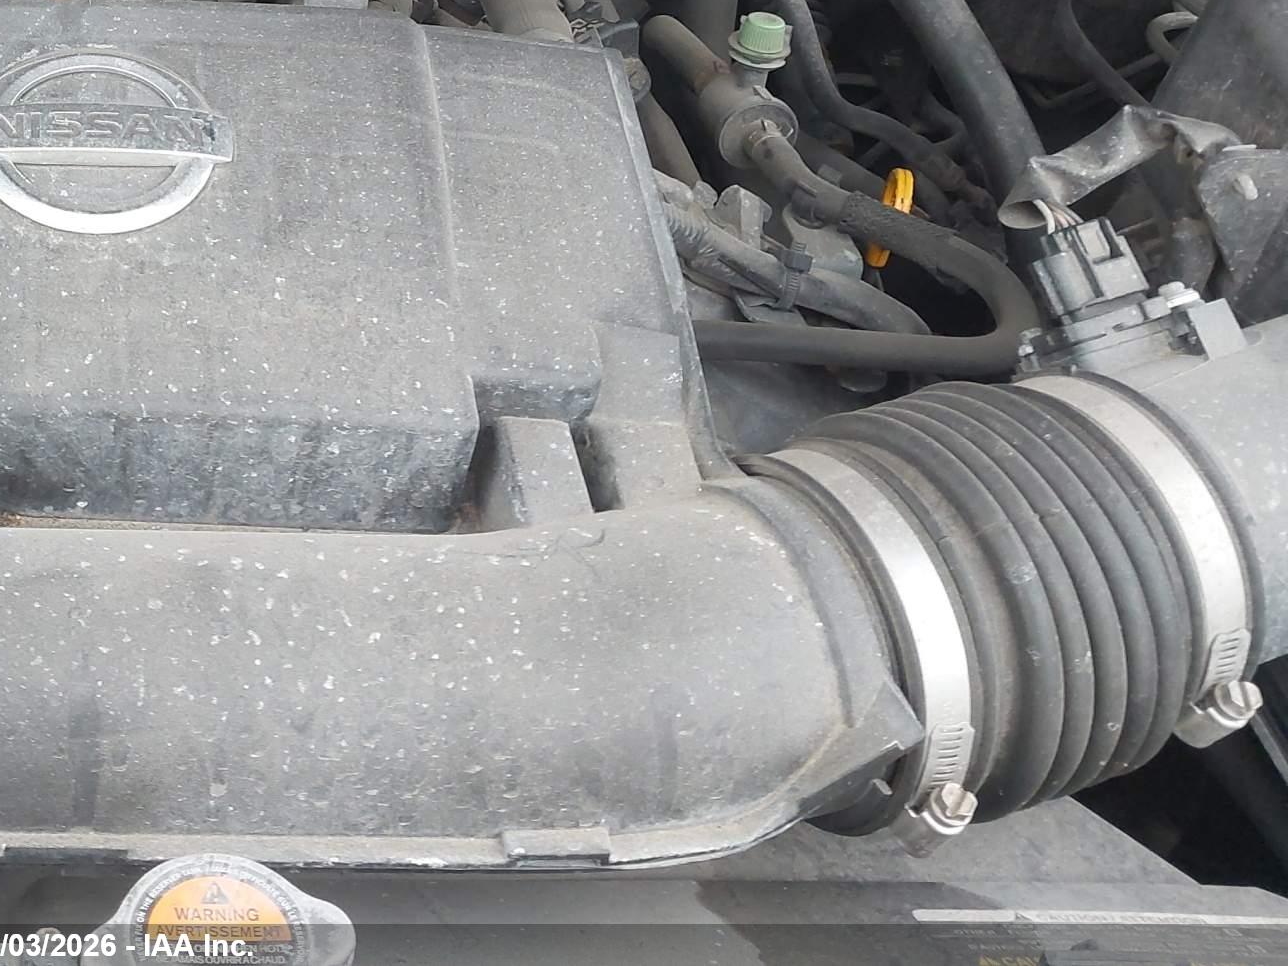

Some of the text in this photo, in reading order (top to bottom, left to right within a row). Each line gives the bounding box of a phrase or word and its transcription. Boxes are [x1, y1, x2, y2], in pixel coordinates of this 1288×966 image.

[139, 894, 155, 910] THE
[136, 909, 146, 923] ON
[175, 907, 260, 921] WARNING
[156, 925, 281, 937] AVERTISSEMENT
